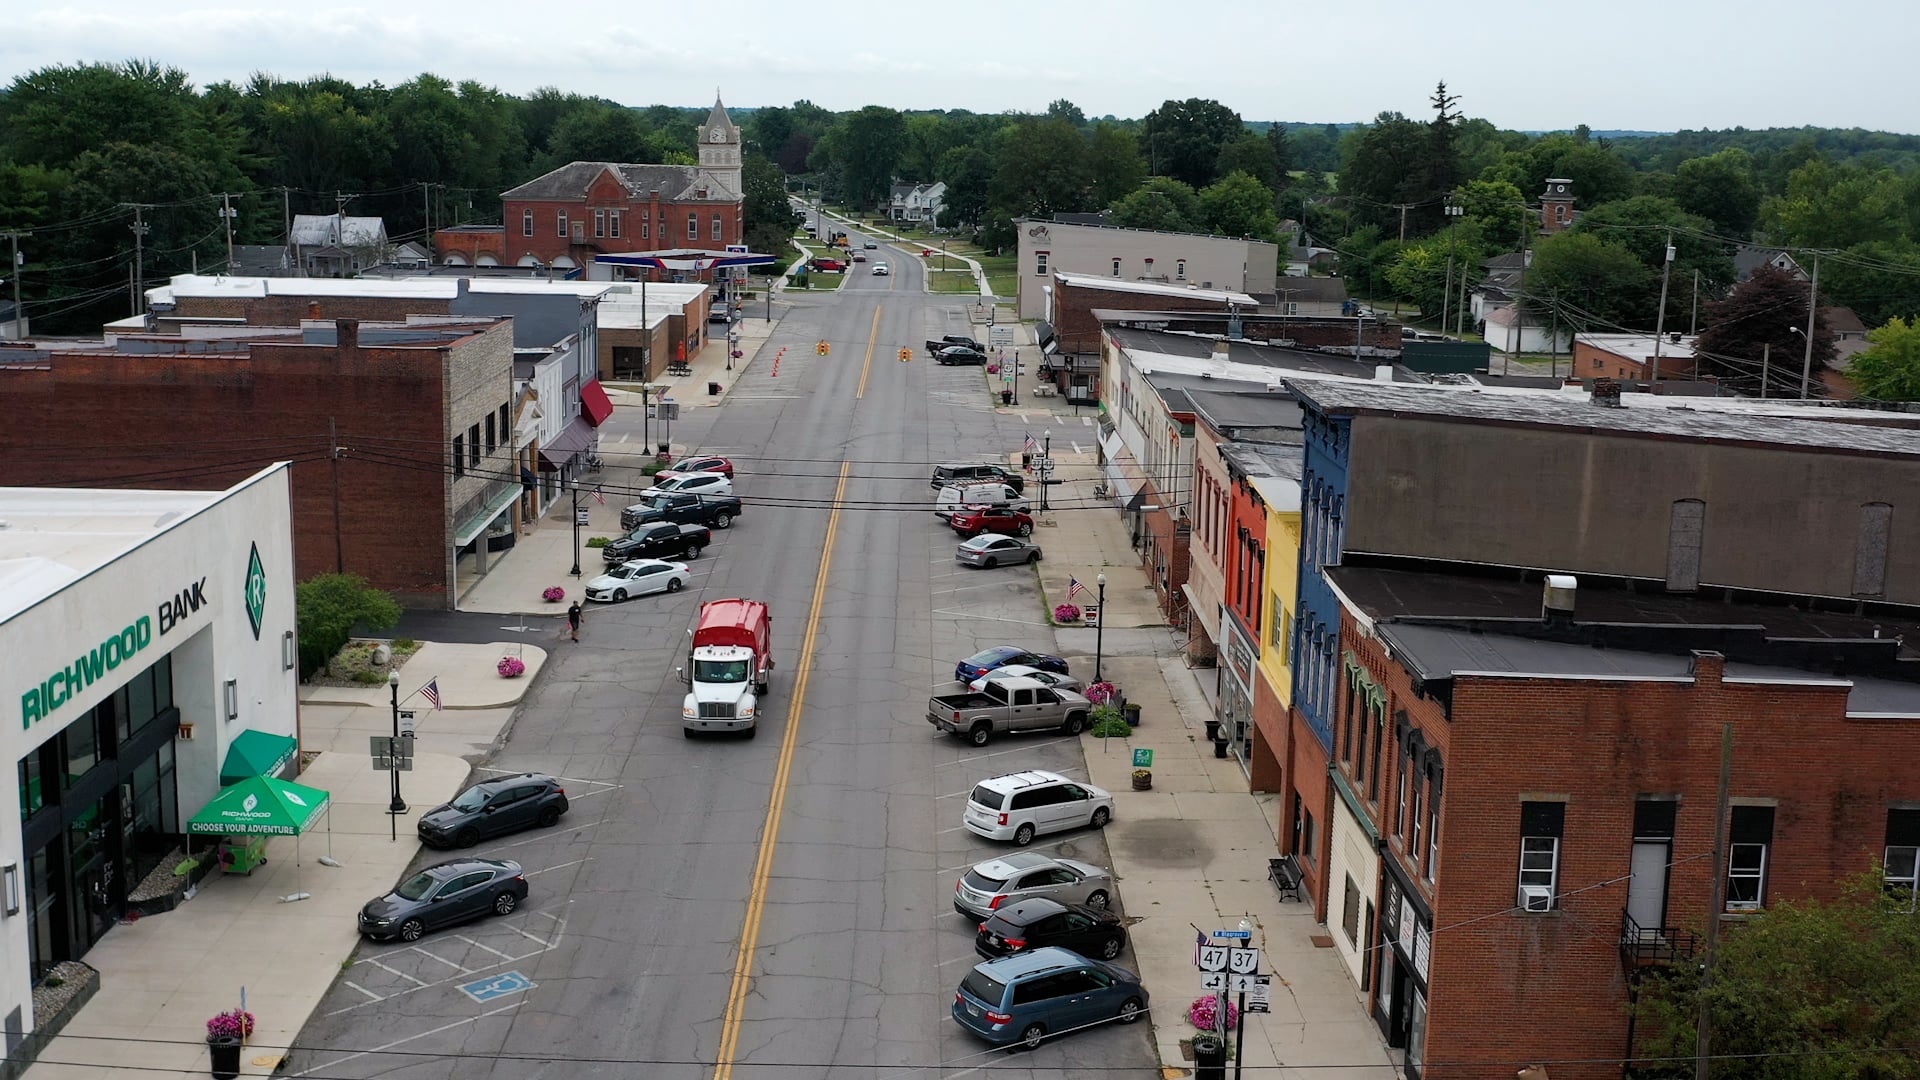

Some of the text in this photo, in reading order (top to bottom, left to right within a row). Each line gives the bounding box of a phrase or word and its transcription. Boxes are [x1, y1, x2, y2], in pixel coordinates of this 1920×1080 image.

[253, 573, 261, 608] R
[22, 576, 207, 730] RICHWOOD BANK
[192, 823, 294, 834] CHOOSE YOUR ADVENTURE
[1204, 950, 1223, 965] 47
[1234, 952, 1253, 967] 37
